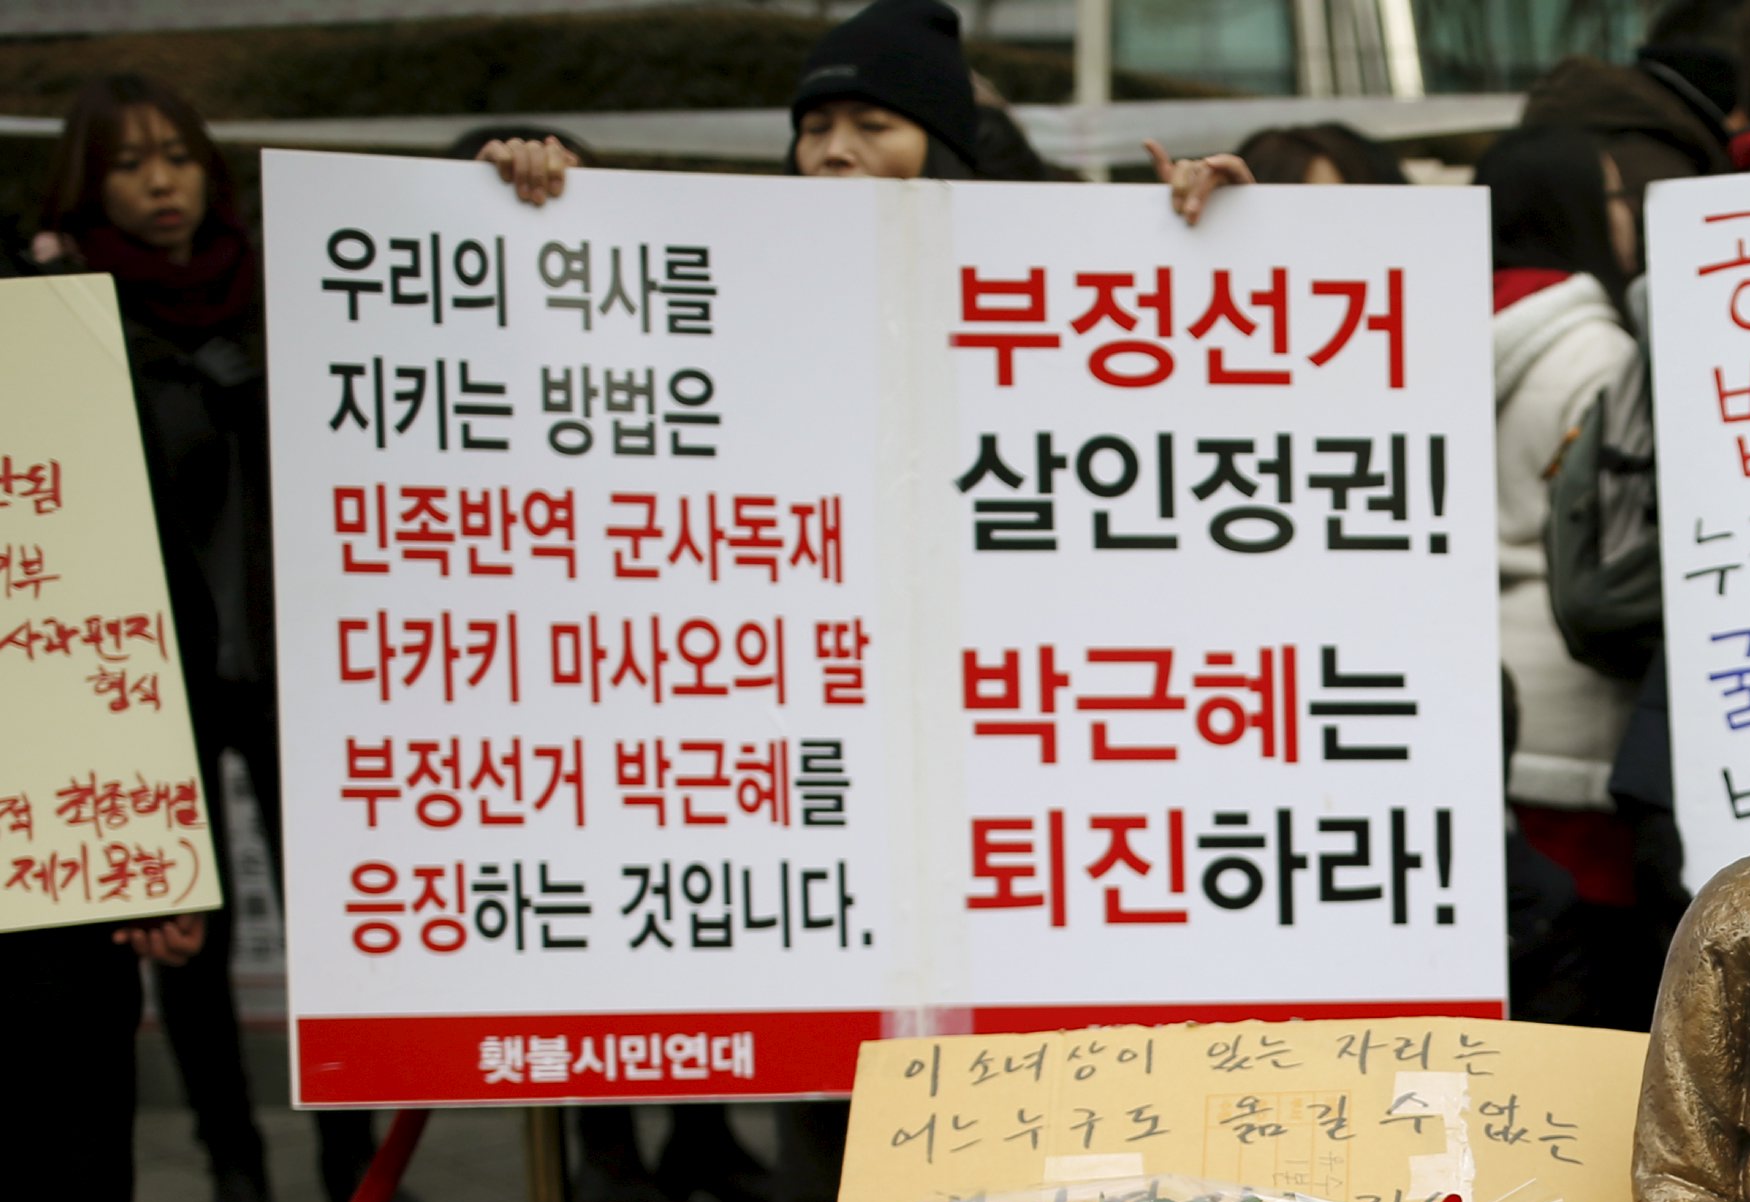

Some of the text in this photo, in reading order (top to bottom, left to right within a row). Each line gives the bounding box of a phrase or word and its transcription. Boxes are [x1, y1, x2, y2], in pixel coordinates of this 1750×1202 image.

[321, 228, 718, 336] 우리의 역사를
[948, 266, 1405, 389] 부정선거
[329, 356, 721, 458] 지키는 방법은
[333, 483, 843, 584] 민족반역 군사독재
[954, 431, 1449, 555] 살인정권!
[337, 609, 870, 706] 다카키 마사오의 딸
[961, 644, 1418, 765] 박근혜는
[340, 736, 851, 829] 부정선거 박근혜를
[344, 861, 592, 956] 응징하는
[621, 861, 873, 949] 것입니다.
[965, 807, 1456, 928] 퇴진하라!
[479, 1033, 755, 1084] 횃불시민연대
[903, 1027, 1503, 1097] 이 소녀상이 있는 자리는
[891, 1090, 1584, 1167] 어느 누구도 옮길 수 없는
